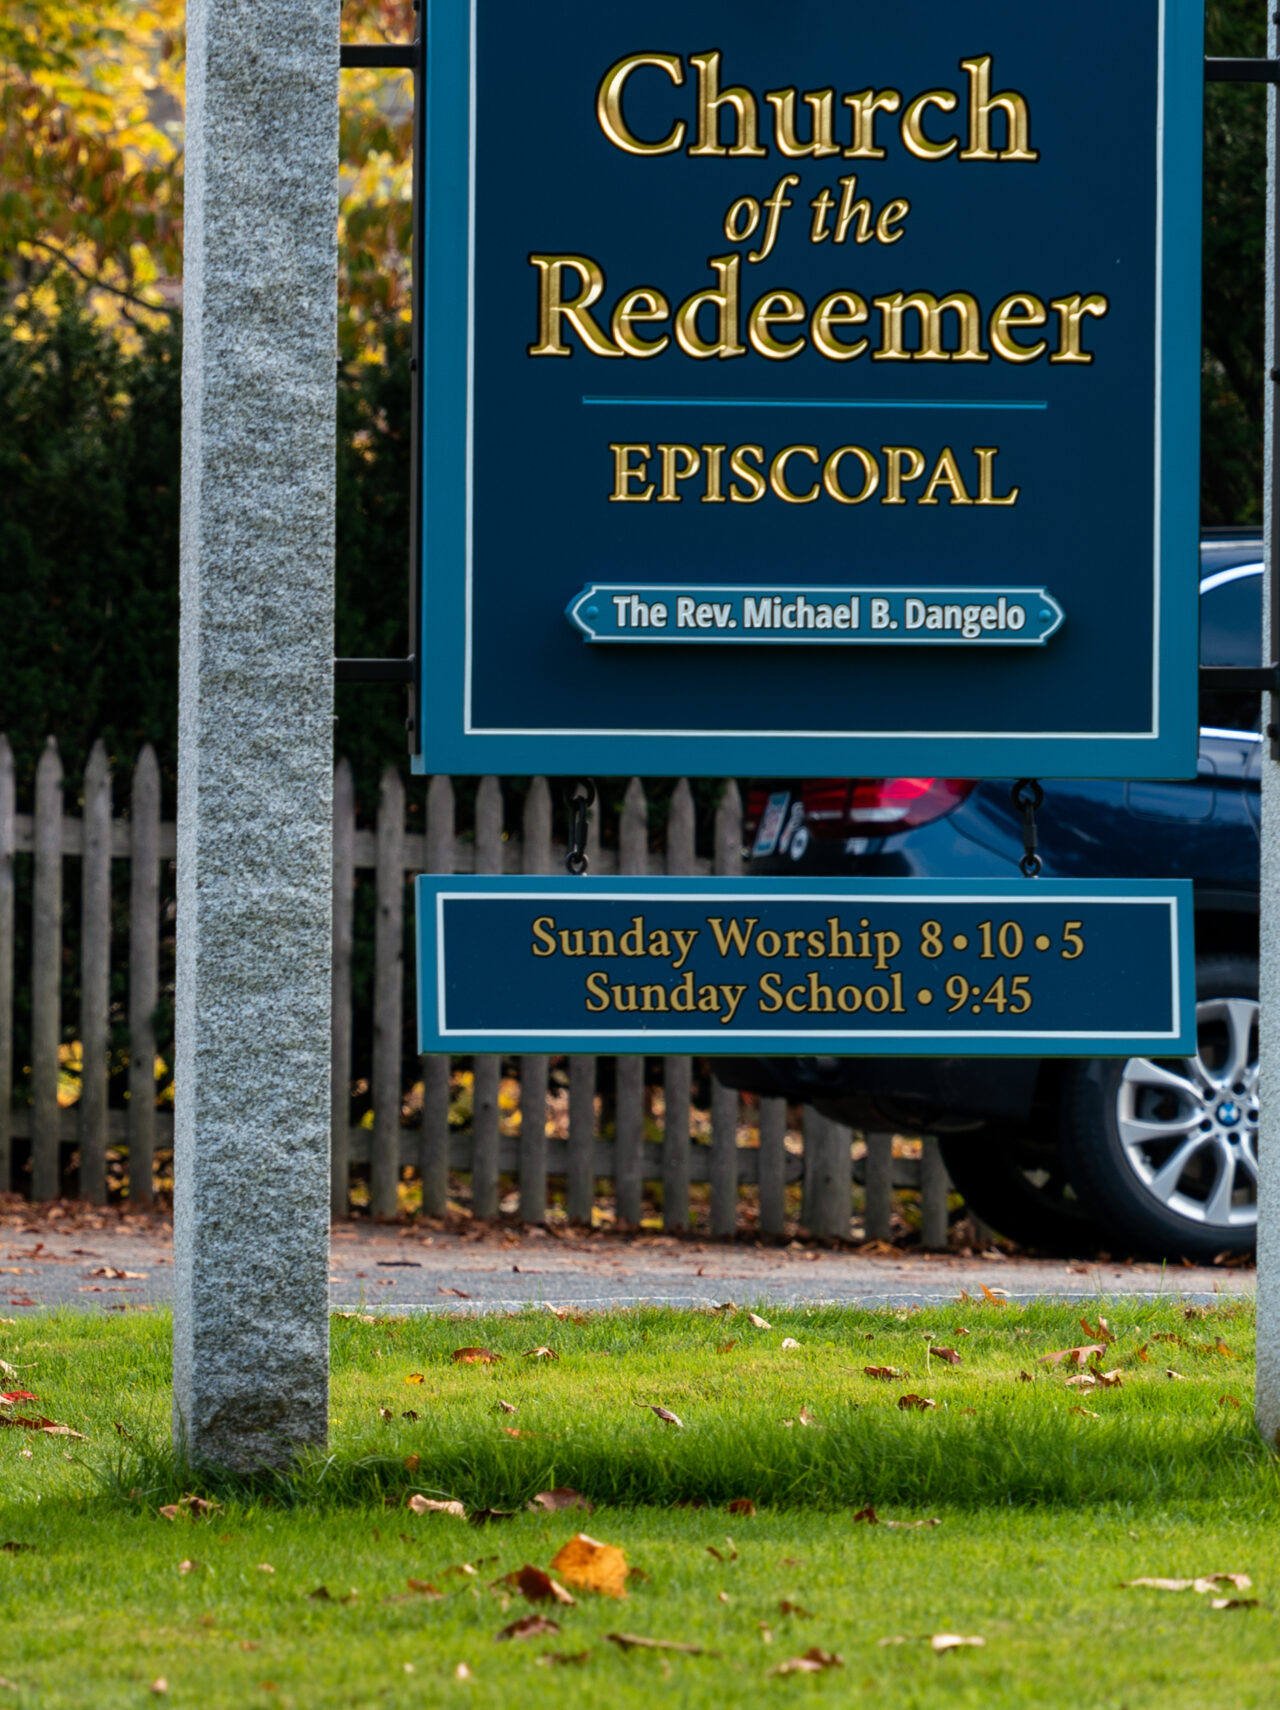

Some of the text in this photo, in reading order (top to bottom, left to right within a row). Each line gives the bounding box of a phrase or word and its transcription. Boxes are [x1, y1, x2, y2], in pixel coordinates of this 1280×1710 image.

[596, 50, 1039, 161] Church
[724, 175, 909, 264] of the
[528, 253, 1107, 363] Redeemer
[608, 443, 1019, 506] EPISCOPAL
[613, 595, 1026, 639] The Rev. Michael B. Dangelo
[531, 916, 699, 968] Sunday
[707, 917, 902, 969] Worship
[585, 972, 1032, 1023] Sunday School 9:45
